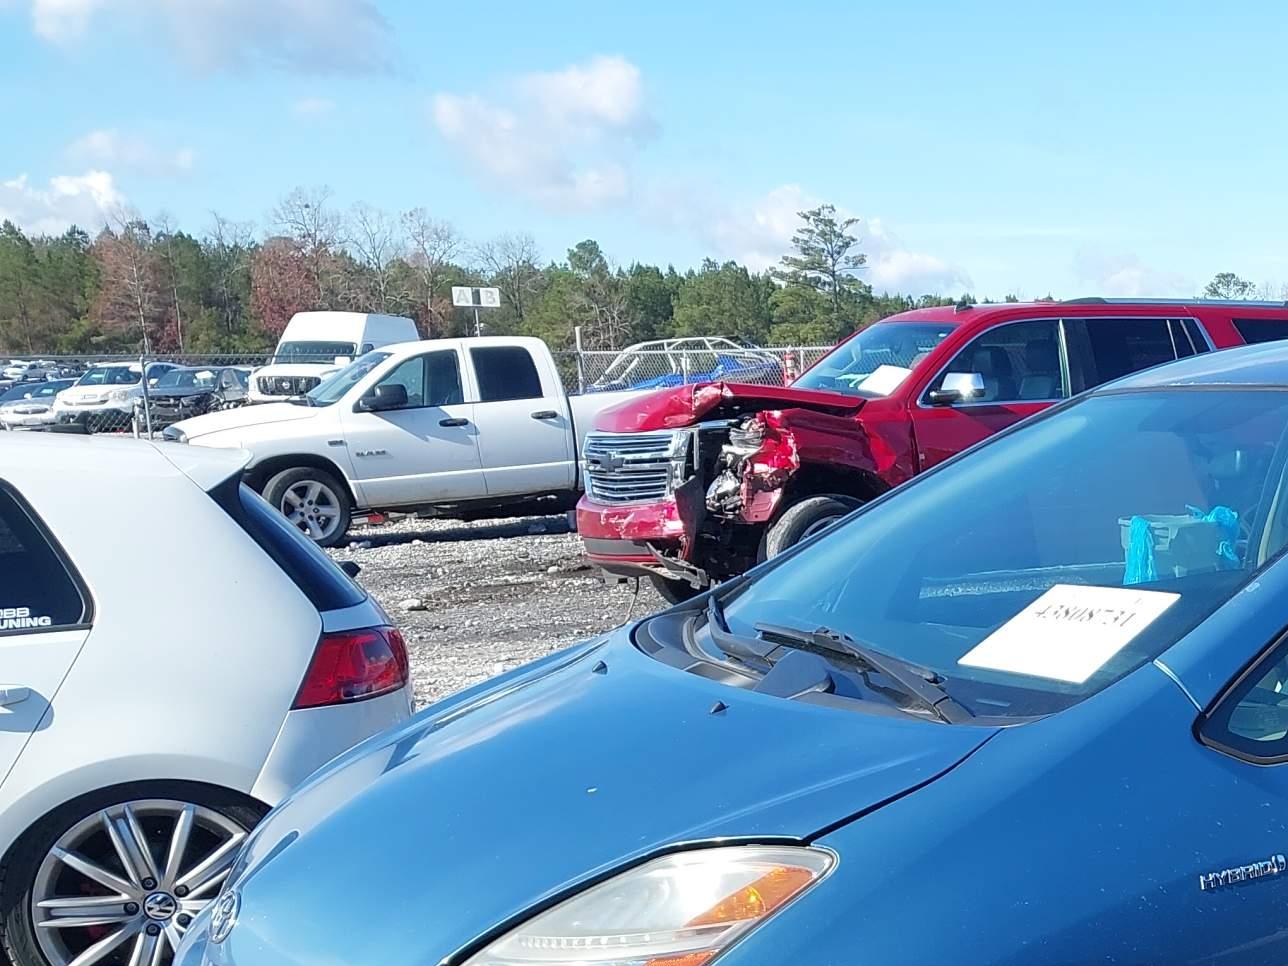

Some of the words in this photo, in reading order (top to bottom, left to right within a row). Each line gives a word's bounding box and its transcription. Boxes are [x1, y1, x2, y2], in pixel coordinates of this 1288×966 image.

[455, 288, 472, 304] A
[482, 289, 496, 305] B
[0, 607, 30, 619] BB
[1200, 860, 1274, 890] HYBRID
